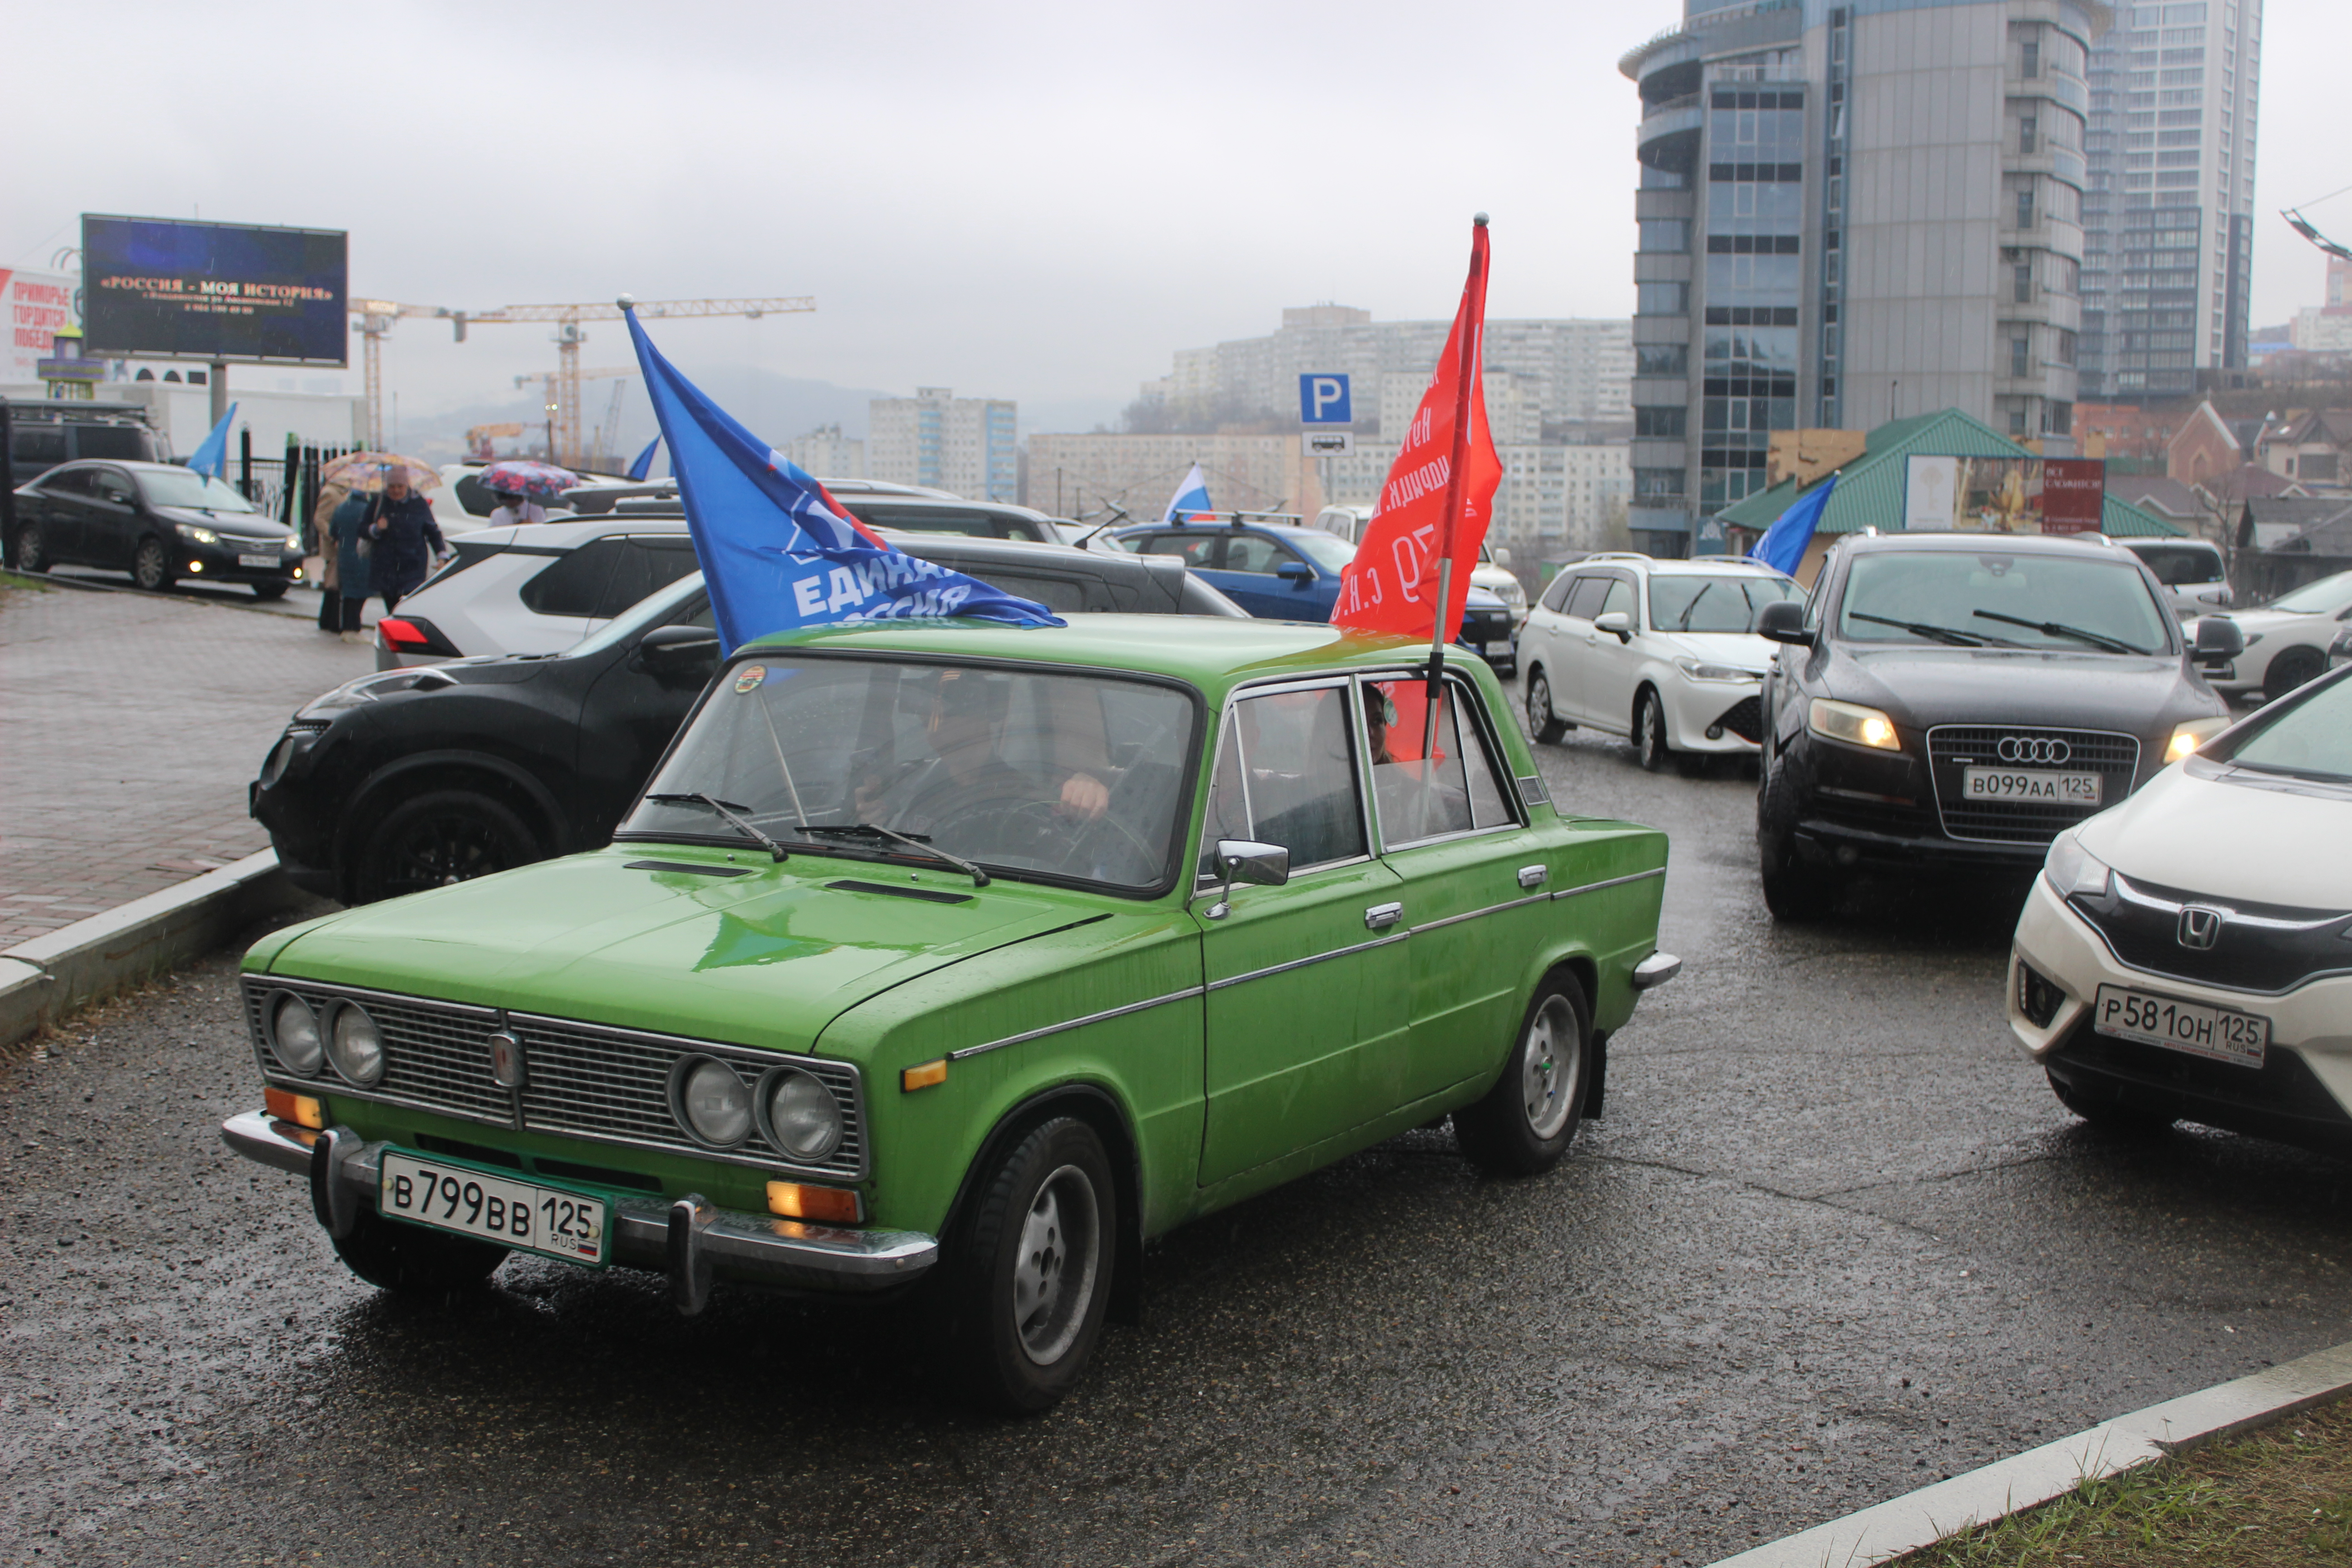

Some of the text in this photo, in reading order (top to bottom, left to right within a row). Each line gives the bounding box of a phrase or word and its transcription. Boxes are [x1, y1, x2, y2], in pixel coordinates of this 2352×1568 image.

[15, 281, 69, 306] ПРИМОРЬЕ
[100, 276, 183, 293] «РОССИЯ
[200, 280, 240, 295] МОЯ
[244, 283, 333, 301] ИСТОРИЯ»
[14, 304, 66, 328] ГОРДИТСЯ
[1313, 377, 1343, 420] P
[792, 553, 956, 617] ЕДИНА
[1973, 774, 2093, 797] В099АА 125
[2104, 996, 2259, 1044] Р581ОН 125
[2225, 1041, 2246, 1054] RUS
[394, 1169, 592, 1239] В799ВВ 125
[550, 1234, 577, 1250] RUS
